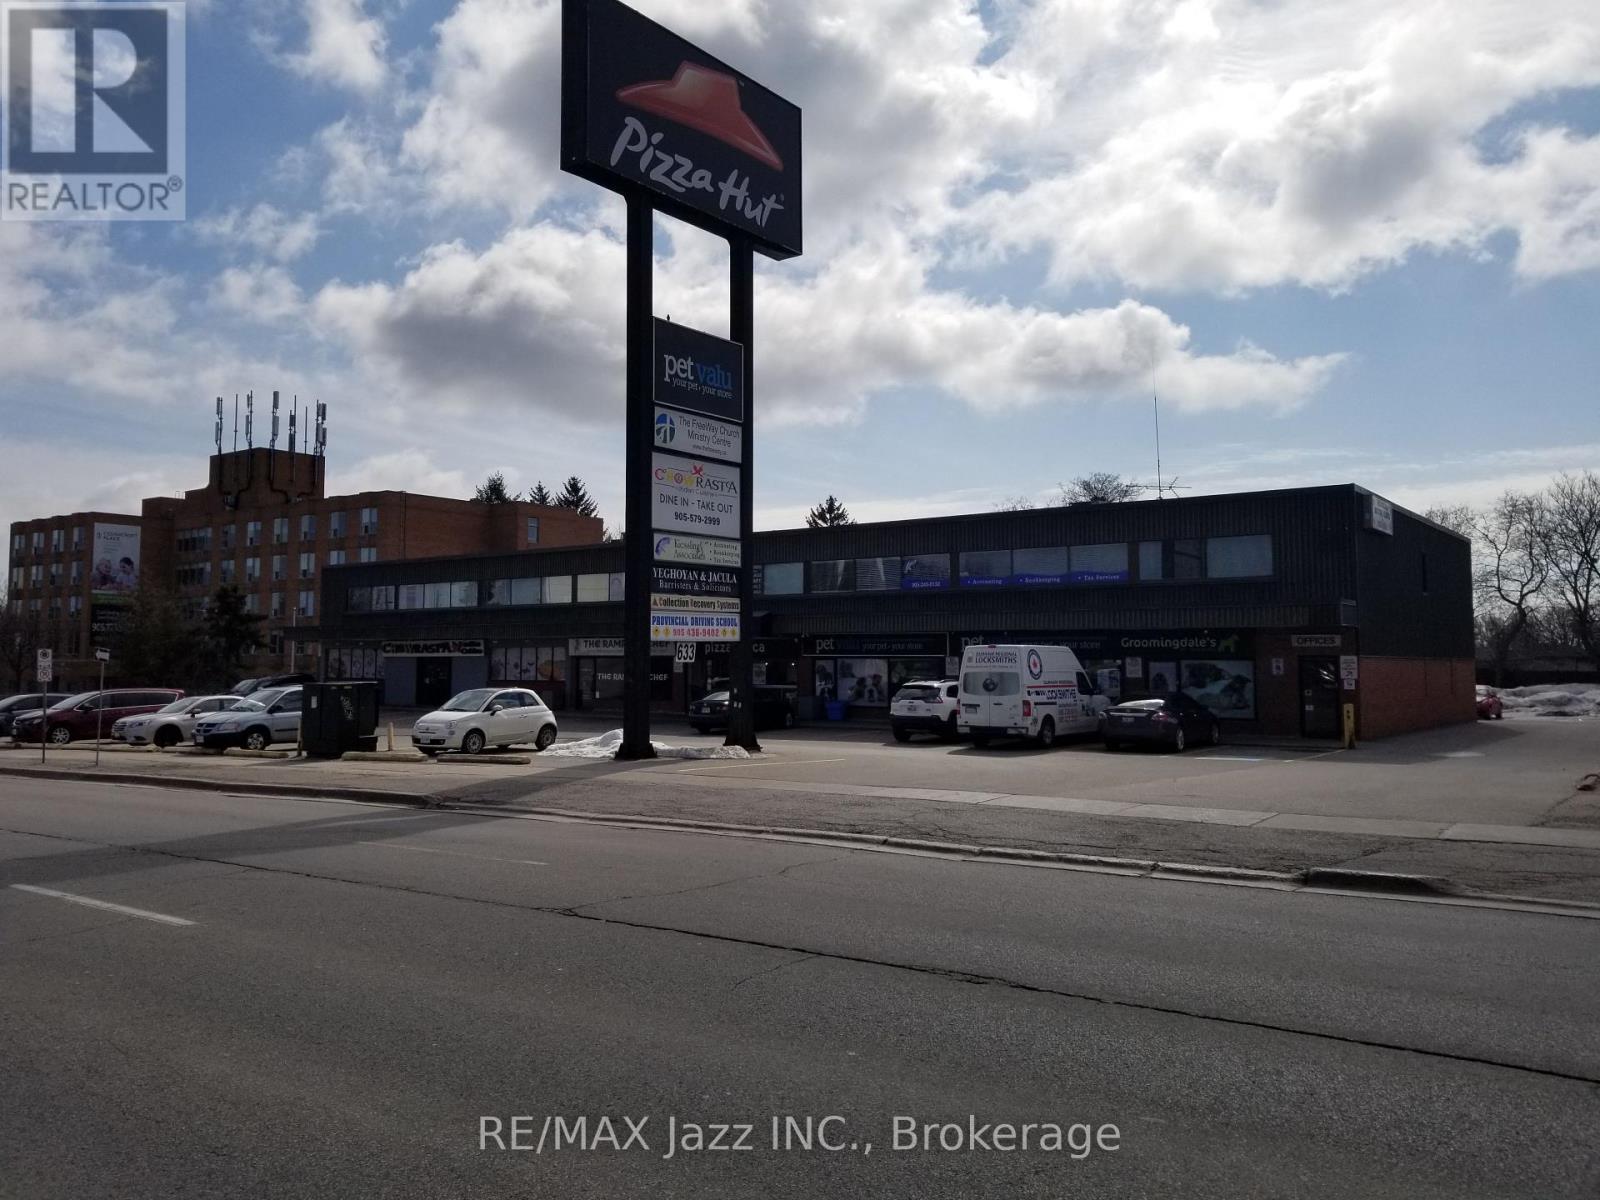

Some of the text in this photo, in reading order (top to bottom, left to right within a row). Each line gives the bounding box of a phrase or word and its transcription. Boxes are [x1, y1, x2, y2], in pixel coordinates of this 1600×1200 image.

[610, 116, 784, 228] Pizza Hut
[663, 354, 734, 390] pet valu
[679, 416, 740, 439] The FreeWay Church
[687, 429, 731, 448] Ministry Centre
[659, 493, 679, 506] DINE
[681, 495, 689, 507] IN
[697, 499, 715, 512] TAKE
[717, 503, 734, 514] OUT
[653, 568, 737, 583] YEGHOYAN & JACULA
[660, 580, 692, 590] Barristers
[702, 583, 732, 592] Solicitors
[660, 597, 689, 608] Collection
[717, 600, 739, 610] Systems
[652, 615, 738, 627] PROVINCIAL DRIVING SCHOOL
[584, 640, 601, 649] THE
[816, 638, 835, 654] pet
[1121, 637, 1217, 649] Groomingdale's
[1297, 637, 1337, 645] OFFICES
[678, 643, 695, 660] 633
[975, 656, 1017, 664] LOCKSMITHS
